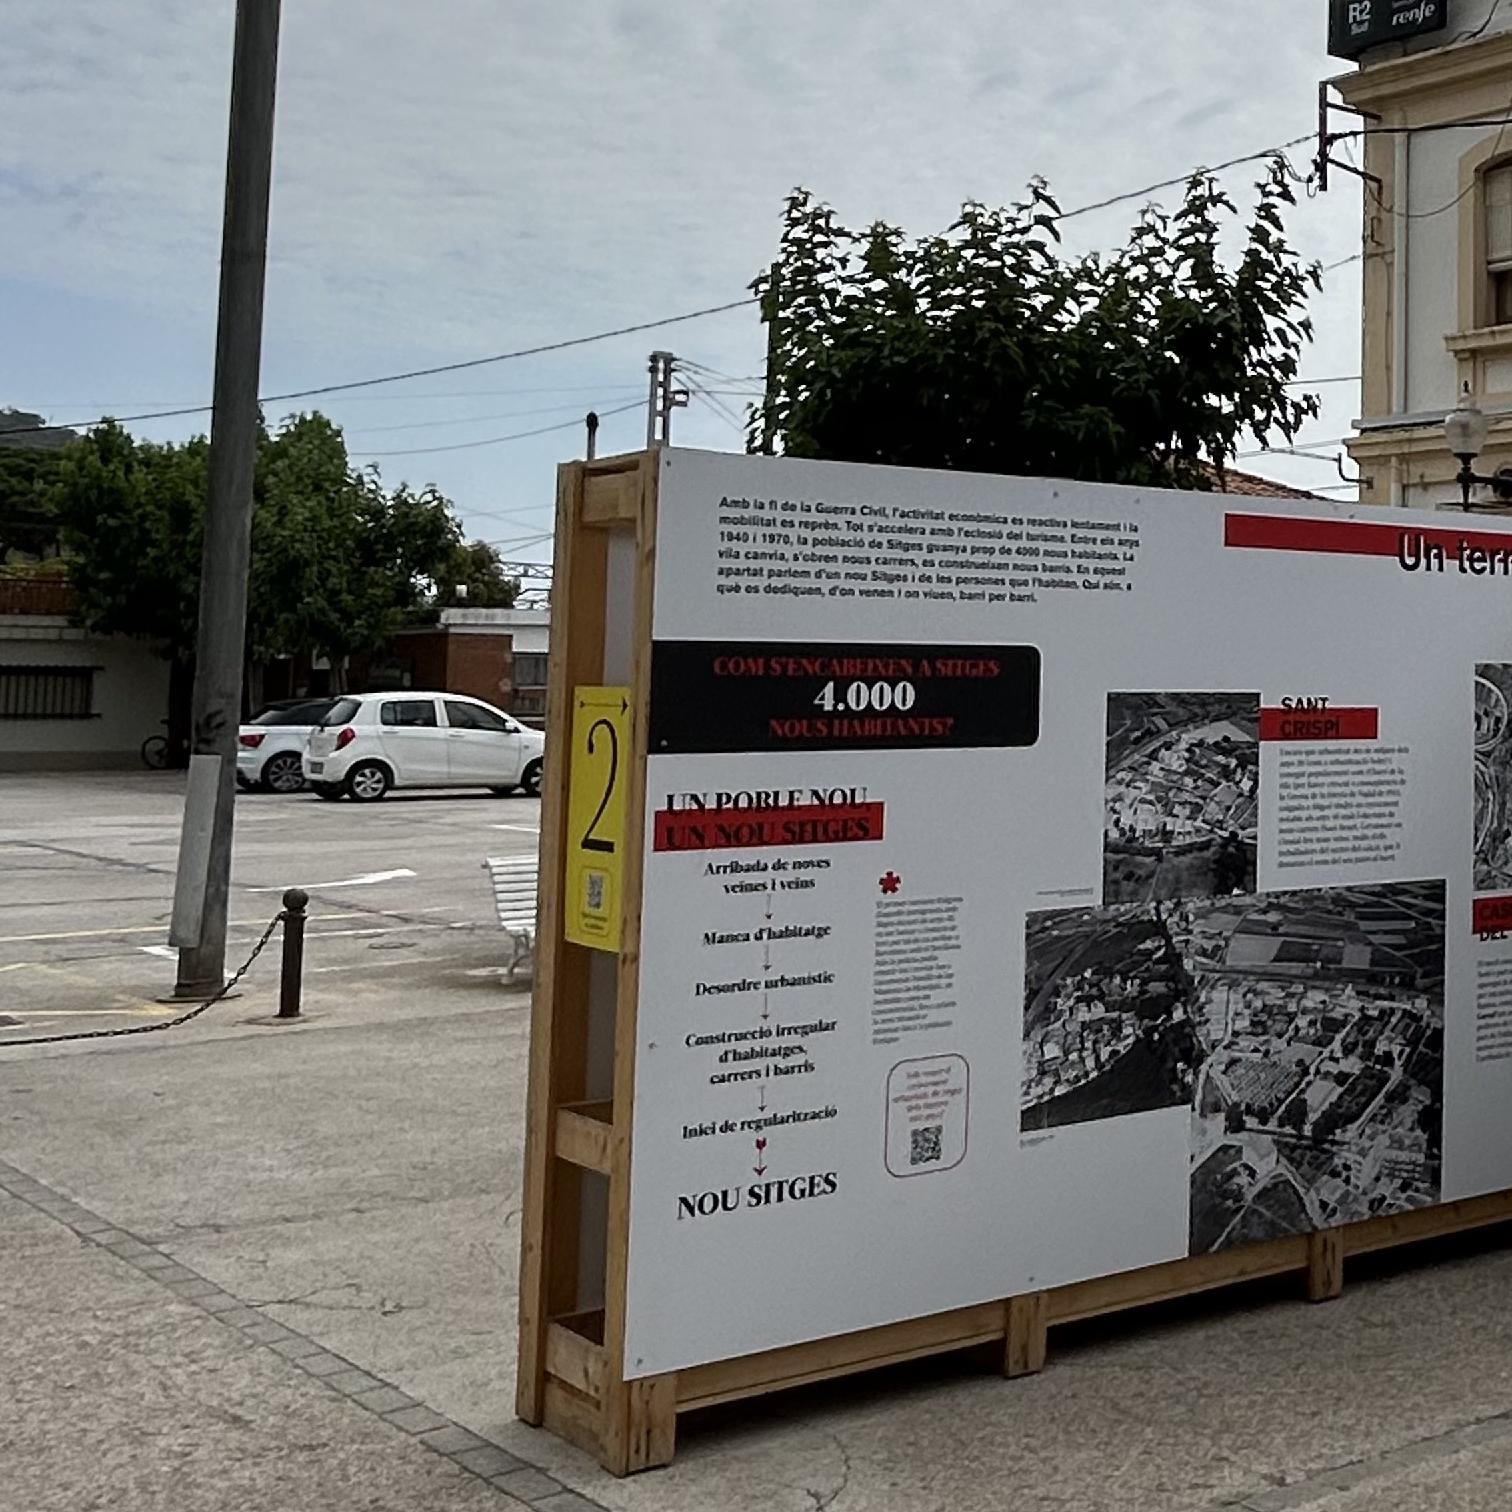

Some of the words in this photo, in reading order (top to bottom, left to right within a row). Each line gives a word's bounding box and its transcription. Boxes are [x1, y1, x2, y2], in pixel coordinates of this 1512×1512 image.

[1349, 1, 1371, 23] R2
[1392, 0, 1435, 26] renfe
[719, 497, 750, 509] Amb
[753, 499, 765, 510] la
[781, 501, 797, 512] de
[800, 501, 811, 513] la
[815, 503, 856, 515] Guerra
[860, 505, 889, 519] Civil,
[719, 515, 777, 527] mobilitat
[929, 527, 955, 537] amb
[720, 531, 749, 543] 1940
[797, 534, 808, 545] la
[812, 536, 865, 548] població
[868, 539, 883, 549] de
[887, 539, 923, 553] Sitges
[1398, 531, 1444, 573] Un
[718, 547, 740, 559] vila
[842, 555, 871, 565] nous
[718, 567, 764, 578] apartat
[844, 572, 867, 581] nou
[745, 585, 760, 593] es
[829, 585, 855, 597] d'on
[713, 656, 765, 676] COM
[919, 657, 932, 676] A
[936, 658, 1000, 676] SITGES
[813, 680, 916, 712] 4.000
[1280, 697, 1330, 715] SANT
[769, 718, 828, 738] NOUS
[833, 717, 954, 736] HABITANTS?
[580, 718, 618, 854] 2
[666, 792, 708, 816] UN
[715, 789, 803, 813] POBLE
[666, 824, 707, 848] UN
[714, 822, 777, 846] NOU
[782, 817, 870, 843] SITGES
[704, 860, 768, 876] Arribada
[771, 859, 788, 872] de
[703, 930, 751, 947] Manca
[695, 979, 762, 997] Desordre
[685, 1027, 772, 1048] Construcció
[776, 1018, 838, 1040] irregular
[710, 1067, 762, 1085] carrers
[773, 1059, 816, 1076] barris
[682, 1122, 716, 1140] Inici
[719, 1119, 737, 1134] de
[676, 1187, 741, 1221] NOU
[747, 1172, 839, 1208] SITGES
